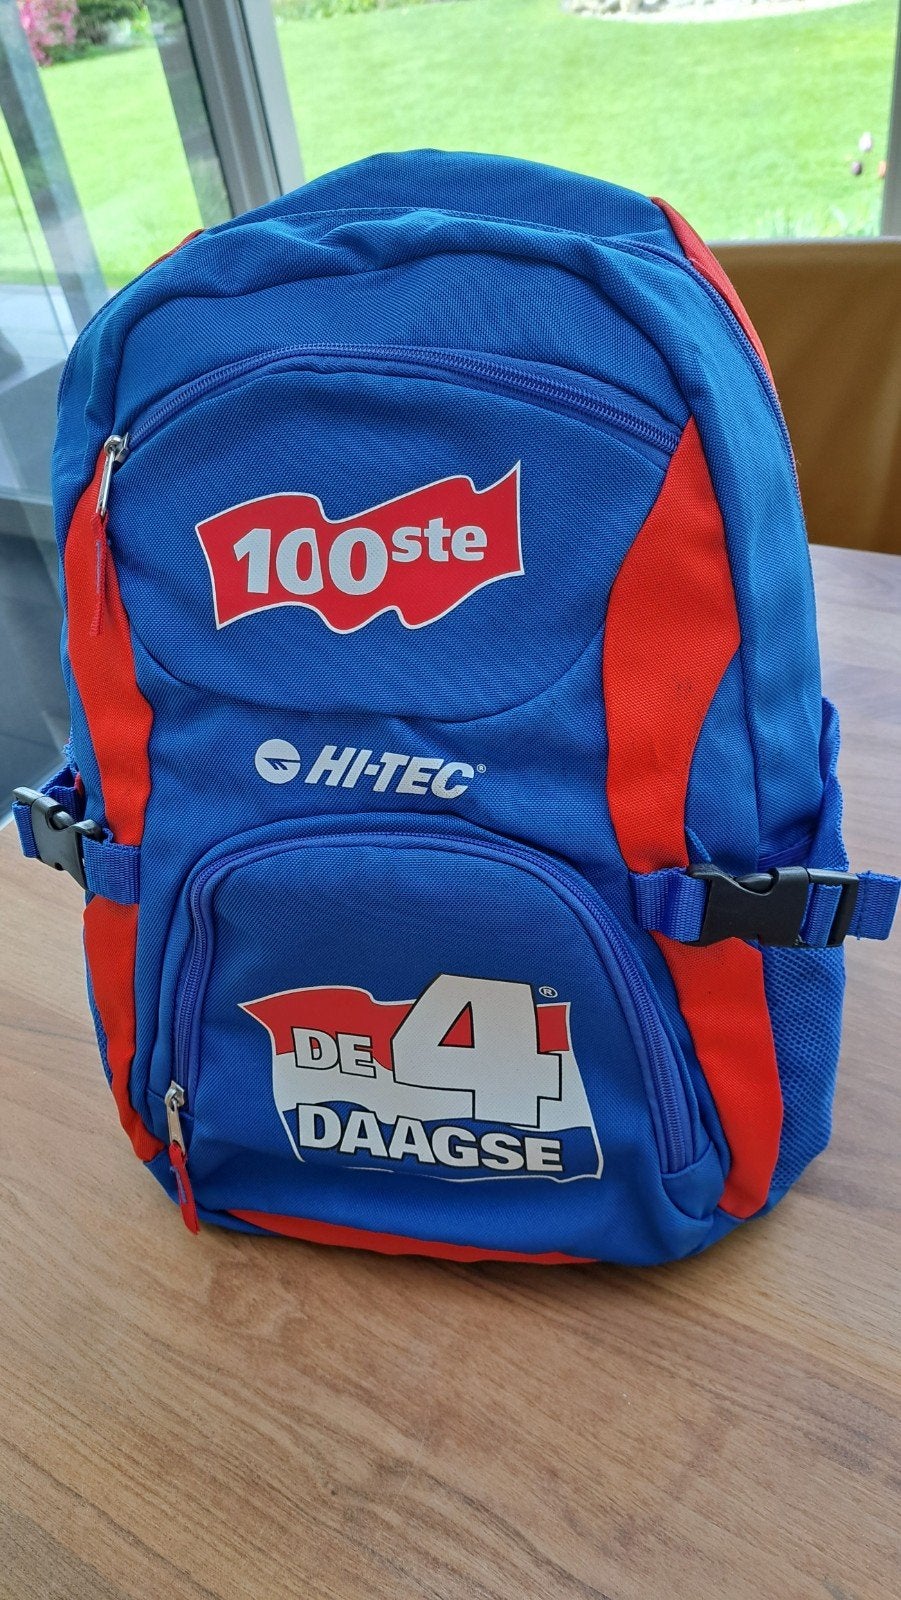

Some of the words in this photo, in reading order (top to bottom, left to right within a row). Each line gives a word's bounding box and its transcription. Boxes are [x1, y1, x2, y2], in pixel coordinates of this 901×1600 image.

[233, 517, 487, 595] 100ste
[304, 745, 475, 799] HI-TEC
[291, 1026, 376, 1078] DE
[391, 973, 562, 1128] 4
[297, 1103, 563, 1172] DAAGSE
